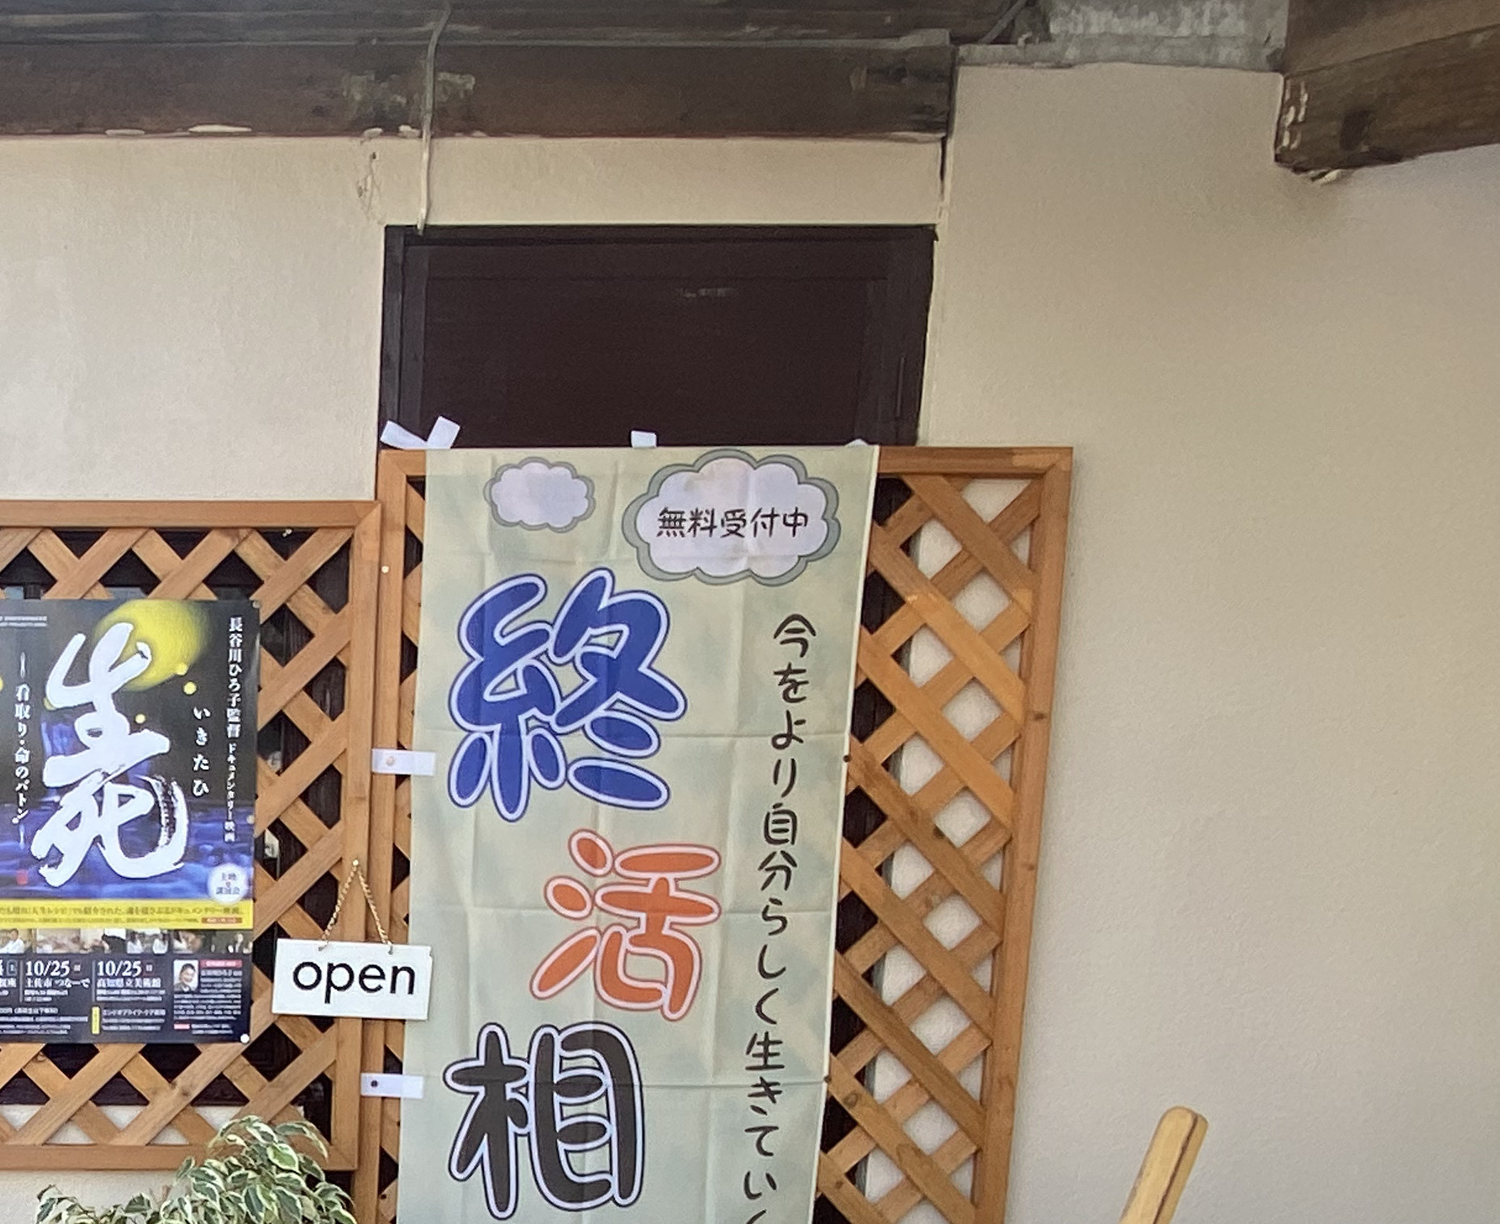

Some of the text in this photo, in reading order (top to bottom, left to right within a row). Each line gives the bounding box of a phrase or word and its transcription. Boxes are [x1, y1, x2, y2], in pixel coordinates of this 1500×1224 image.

[656, 507, 810, 540] 無料受付中
[191, 706, 211, 797] いきたひ
[25, 961, 70, 977] 10/25
[97, 960, 142, 977] 10/25
[293, 961, 415, 1004] open
